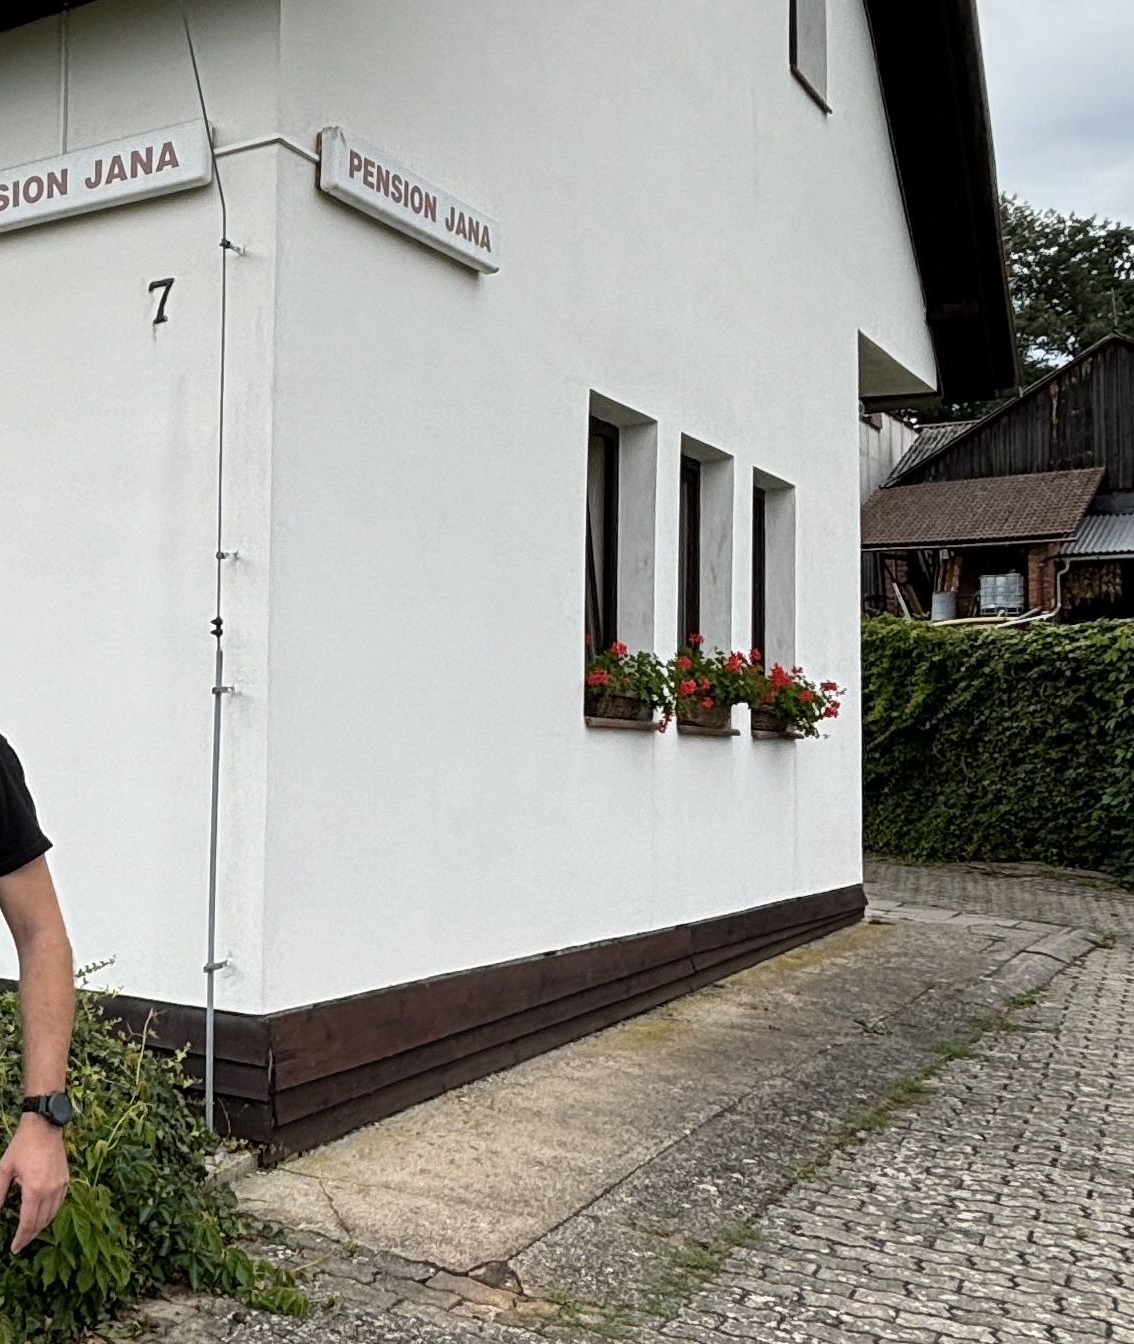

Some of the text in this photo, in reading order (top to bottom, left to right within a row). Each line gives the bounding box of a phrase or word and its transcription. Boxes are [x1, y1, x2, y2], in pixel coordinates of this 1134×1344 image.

[84, 141, 179, 190] JANA
[348, 148, 492, 253] PENSION JANA
[148, 277, 175, 324] 7
